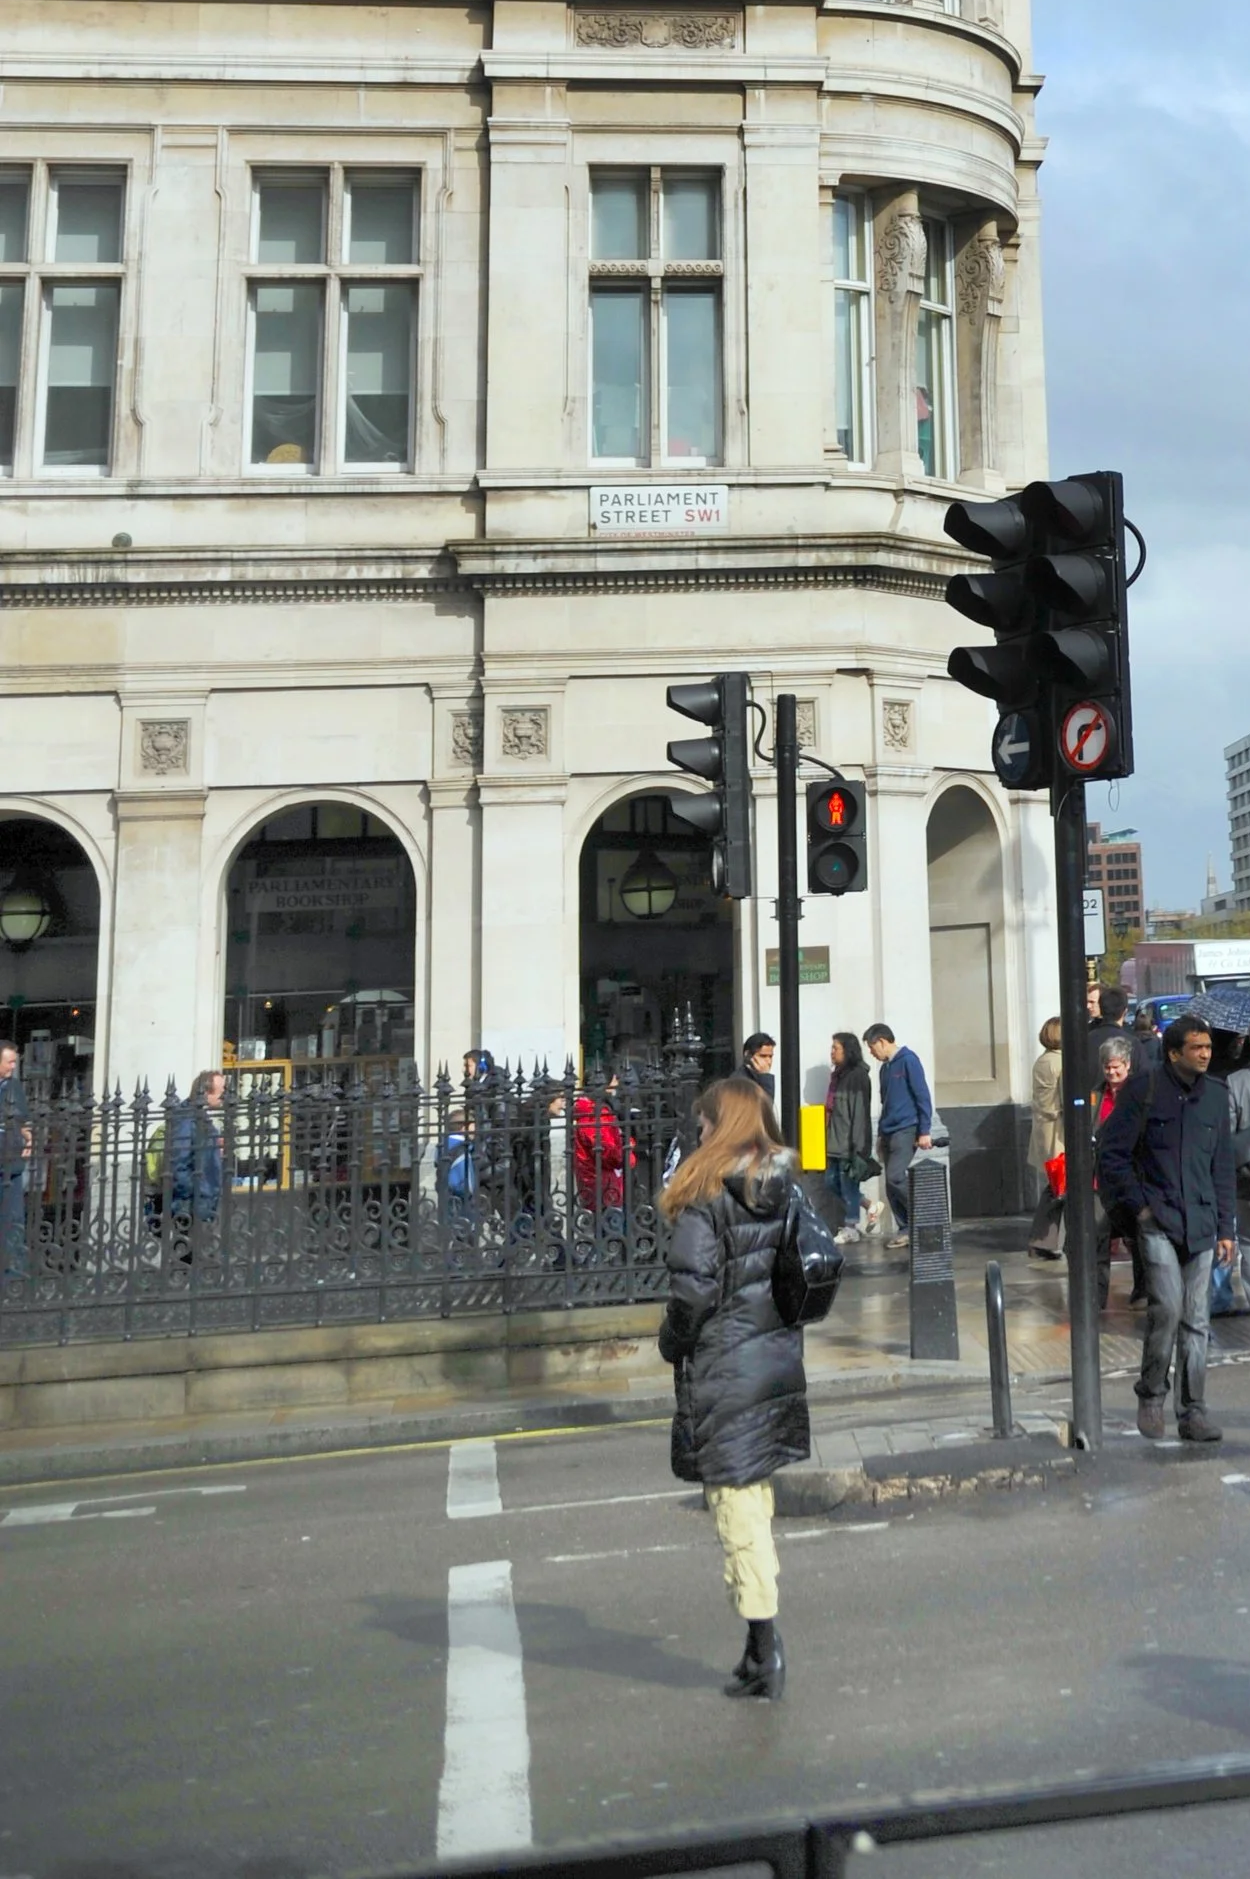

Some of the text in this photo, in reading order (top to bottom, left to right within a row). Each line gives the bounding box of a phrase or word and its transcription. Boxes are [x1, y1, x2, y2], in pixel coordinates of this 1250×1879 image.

[599, 492, 719, 507] PARLIAMENT
[600, 508, 720, 524] STREET SW1
[248, 876, 395, 893] PARLIAMENTARY
[276, 892, 370, 908] BOOKSHOP
